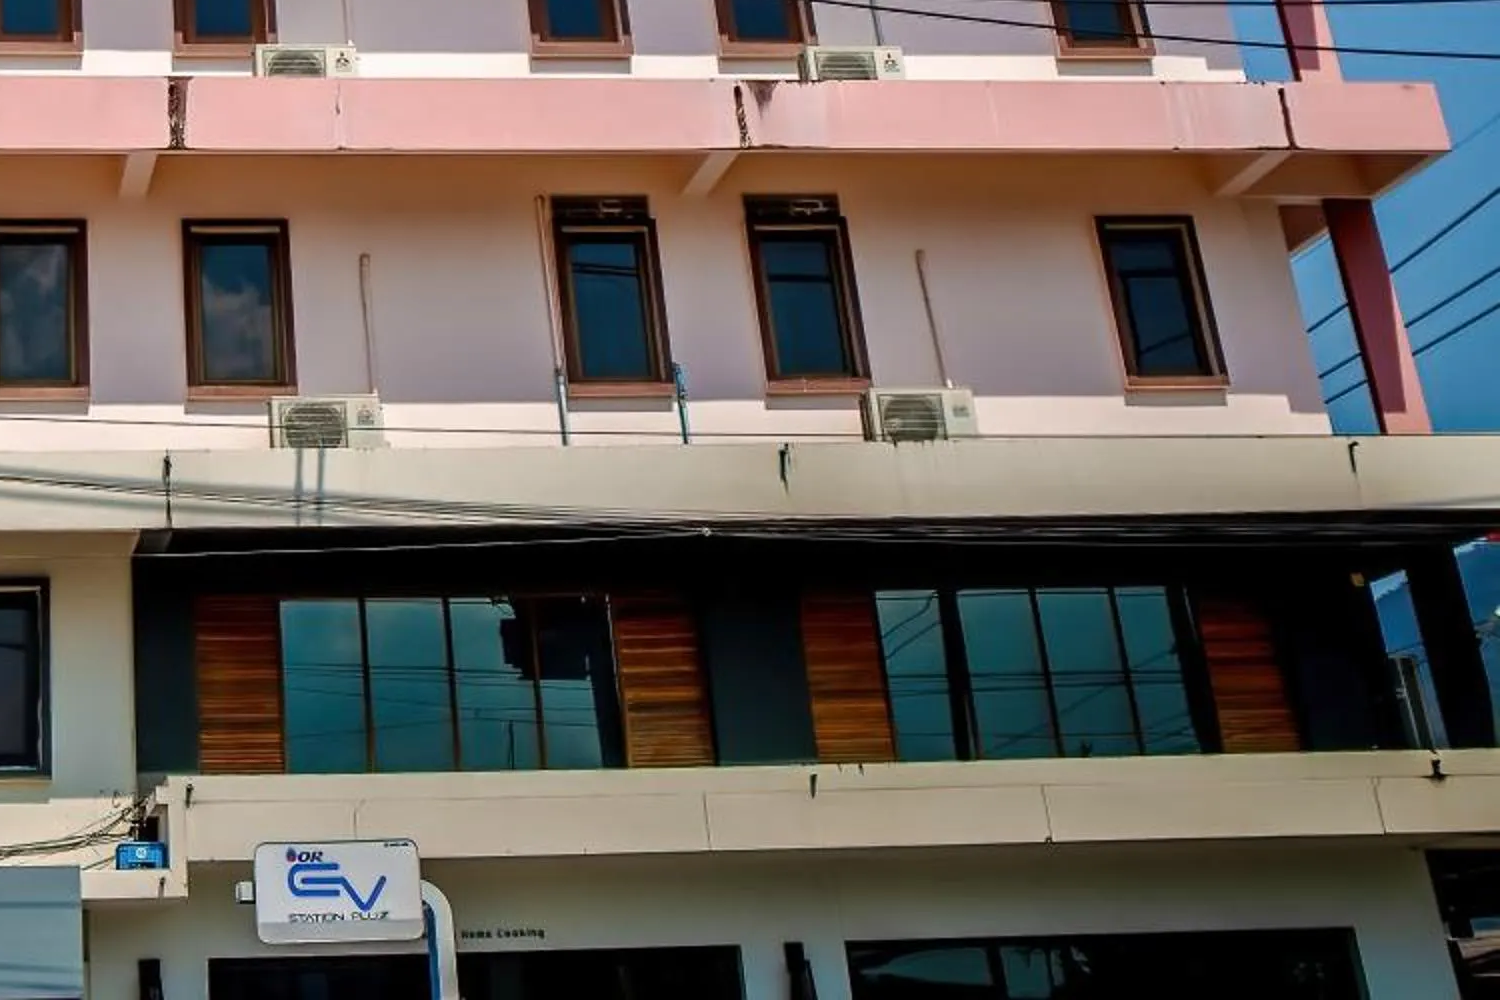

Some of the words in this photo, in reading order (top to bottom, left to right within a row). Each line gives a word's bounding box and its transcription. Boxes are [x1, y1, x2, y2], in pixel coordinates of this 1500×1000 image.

[297, 851, 323, 862] OR
[288, 863, 387, 911] EV
[289, 912, 345, 922] STATION
[461, 928, 492, 938] Home
[497, 927, 545, 939] Cooking
